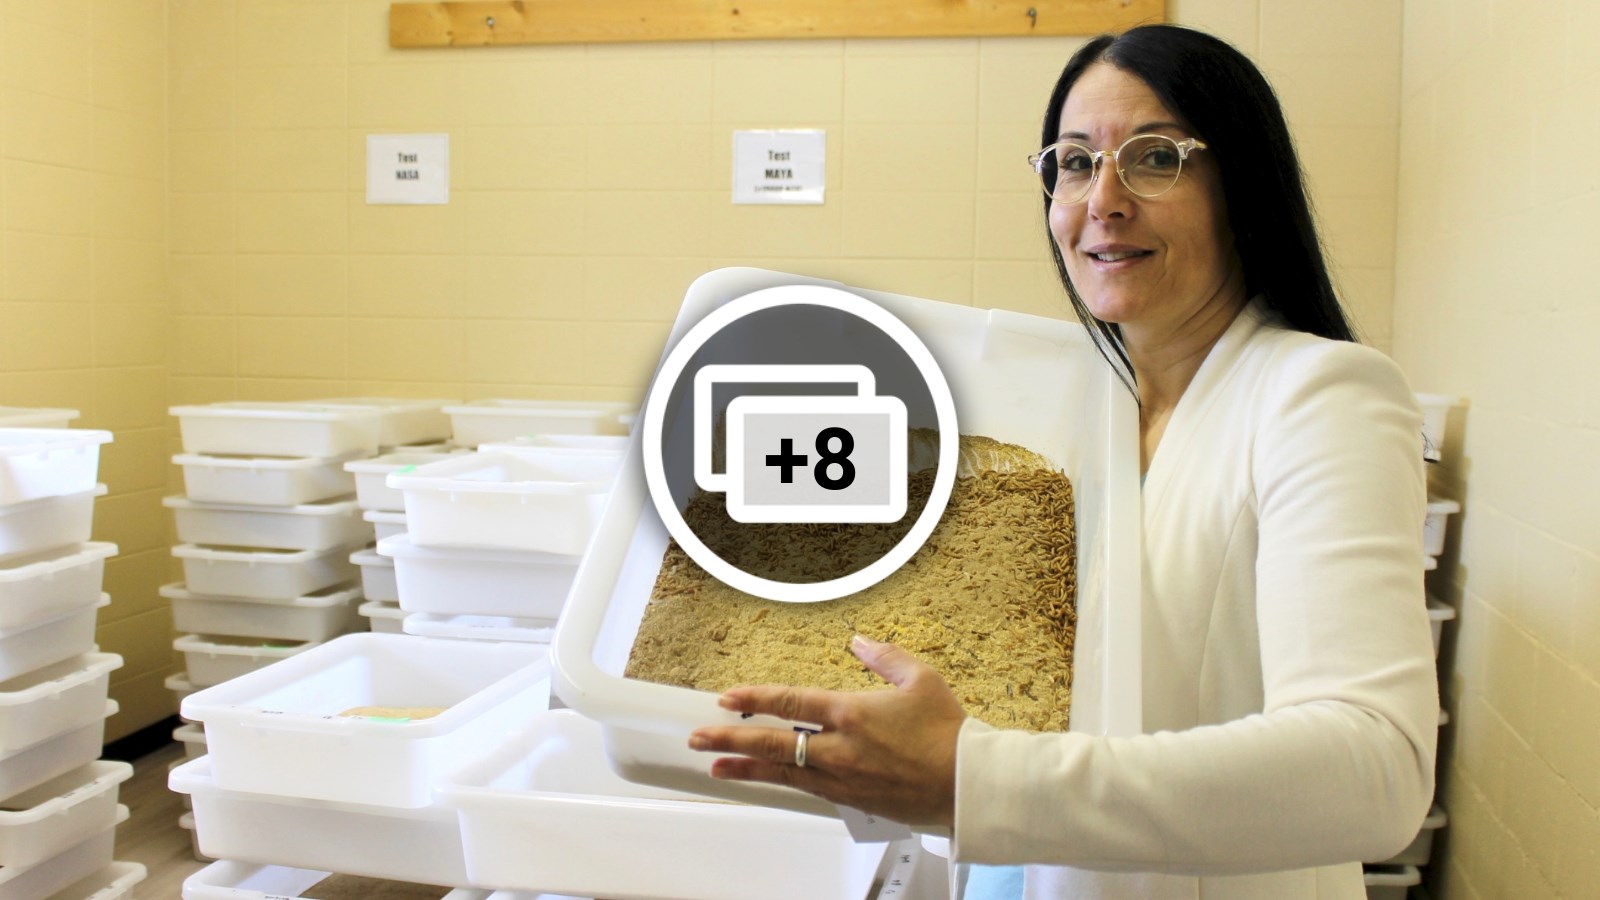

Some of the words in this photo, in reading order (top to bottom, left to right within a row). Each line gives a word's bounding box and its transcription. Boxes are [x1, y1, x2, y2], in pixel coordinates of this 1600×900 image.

[397, 152, 418, 163] Test
[768, 150, 790, 161] Test
[765, 168, 793, 179] MAYA
